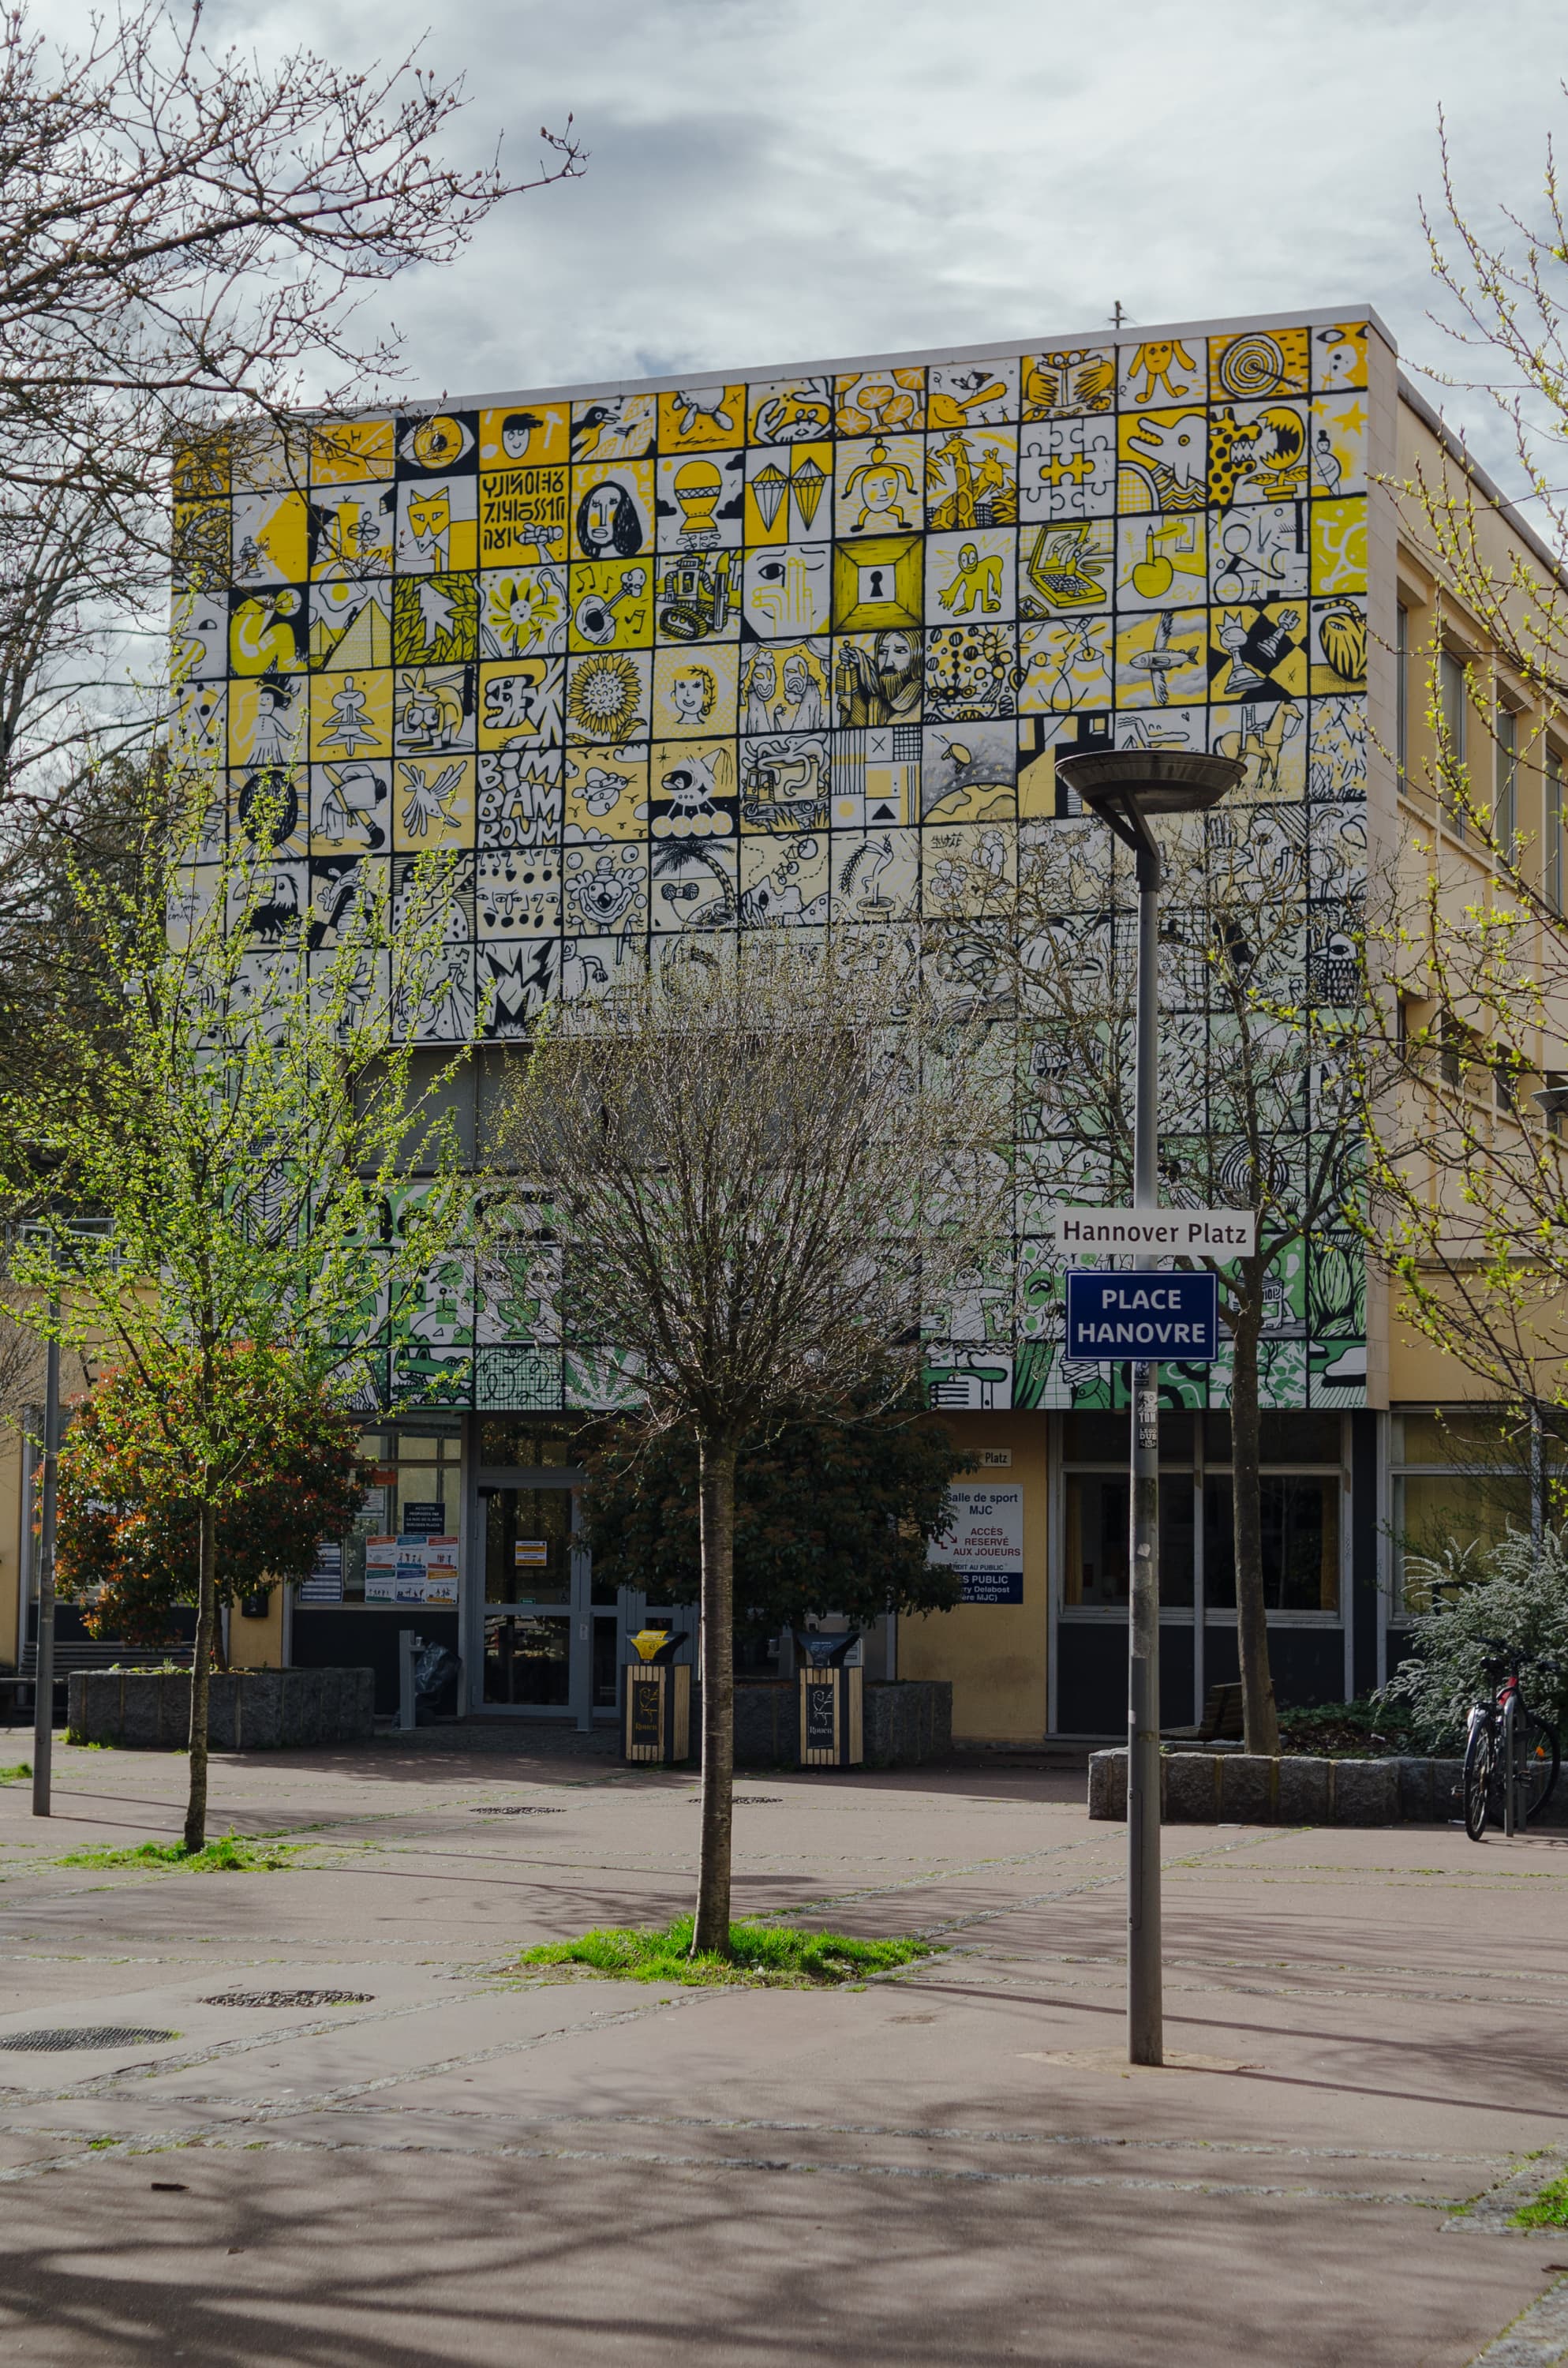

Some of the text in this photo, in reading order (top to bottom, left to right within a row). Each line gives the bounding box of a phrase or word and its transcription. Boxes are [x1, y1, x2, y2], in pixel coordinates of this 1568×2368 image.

[477, 780, 562, 821] BAM
[1063, 1220, 1248, 1245] Hannover Platz
[1102, 1289, 1182, 1310] PLACE
[1077, 1323, 1206, 1343] HANOVRE
[985, 1452, 1008, 1463] Platz
[946, 1493, 1018, 1504] Salle de sport
[969, 1505, 993, 1515] MJC
[975, 1548, 1020, 1557] JOUEURS
[971, 1575, 1009, 1584] PUBLIC
[810, 1725, 833, 1735] Rouen
